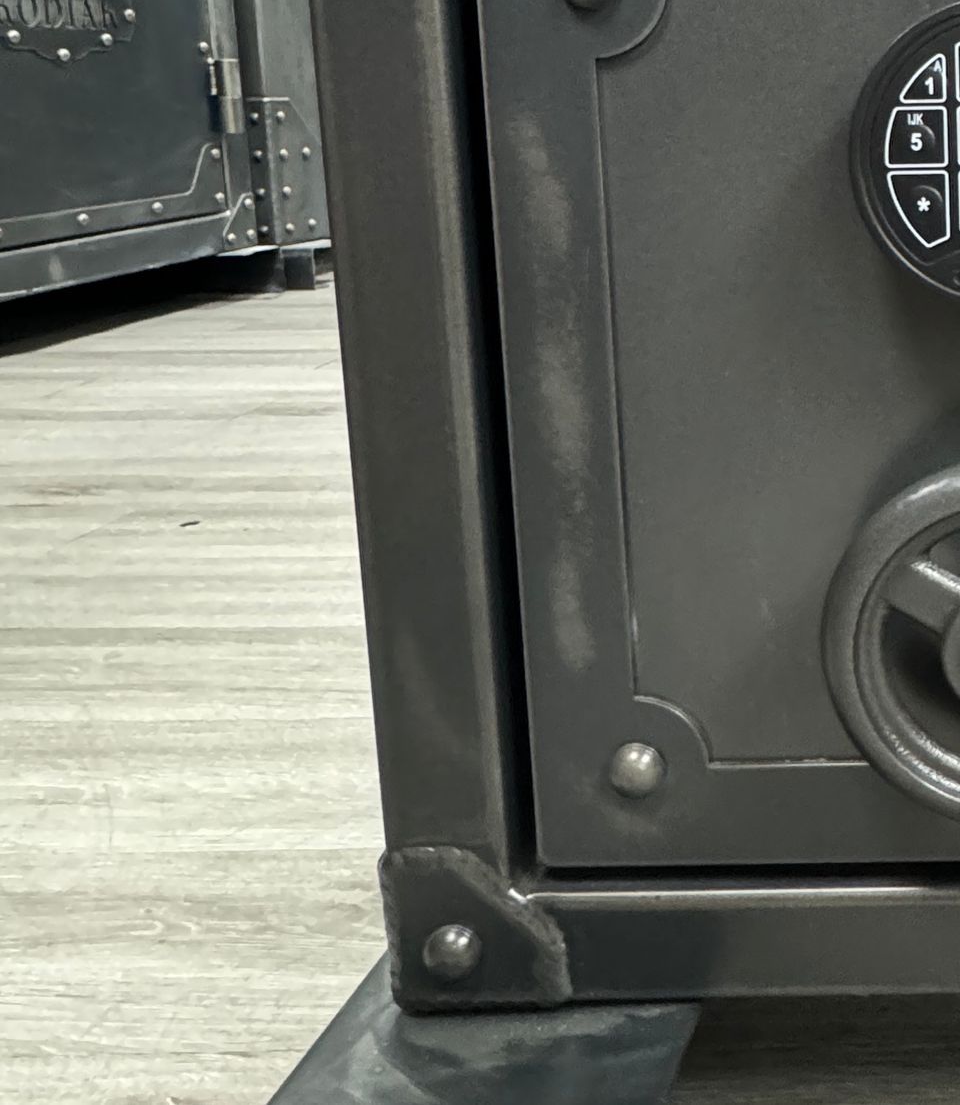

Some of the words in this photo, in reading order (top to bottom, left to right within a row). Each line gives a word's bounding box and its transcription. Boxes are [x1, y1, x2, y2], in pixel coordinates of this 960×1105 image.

[933, 61, 942, 72] A
[924, 77, 935, 95] 1
[907, 113, 924, 125] IJK
[910, 133, 923, 151] 5
